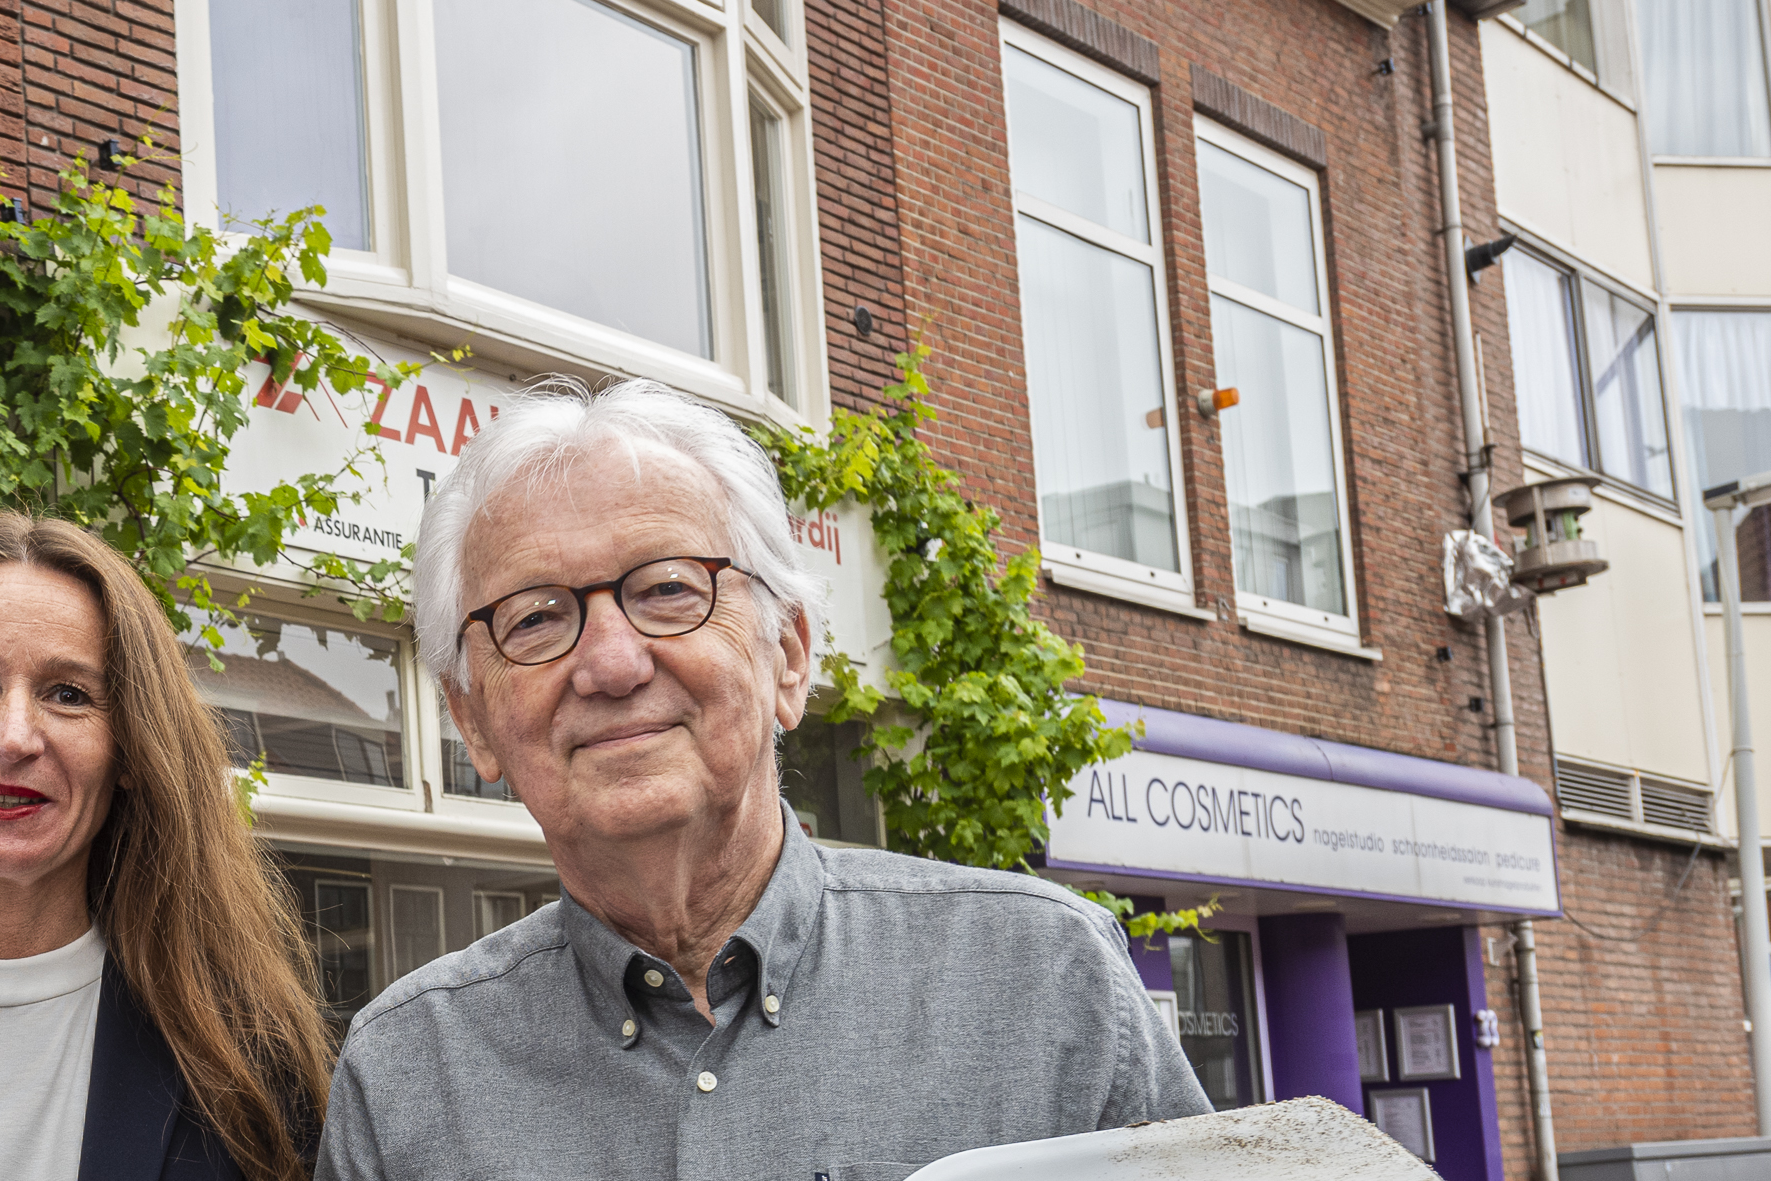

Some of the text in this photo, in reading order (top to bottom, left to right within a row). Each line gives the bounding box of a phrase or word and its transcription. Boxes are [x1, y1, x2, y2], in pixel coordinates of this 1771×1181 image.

[366, 370, 499, 457] ZAA
[314, 516, 403, 549] ASSURANTIE
[1087, 769, 1541, 873] ALL COSMETICS nagelstudio schoonheidssalon pedicure
